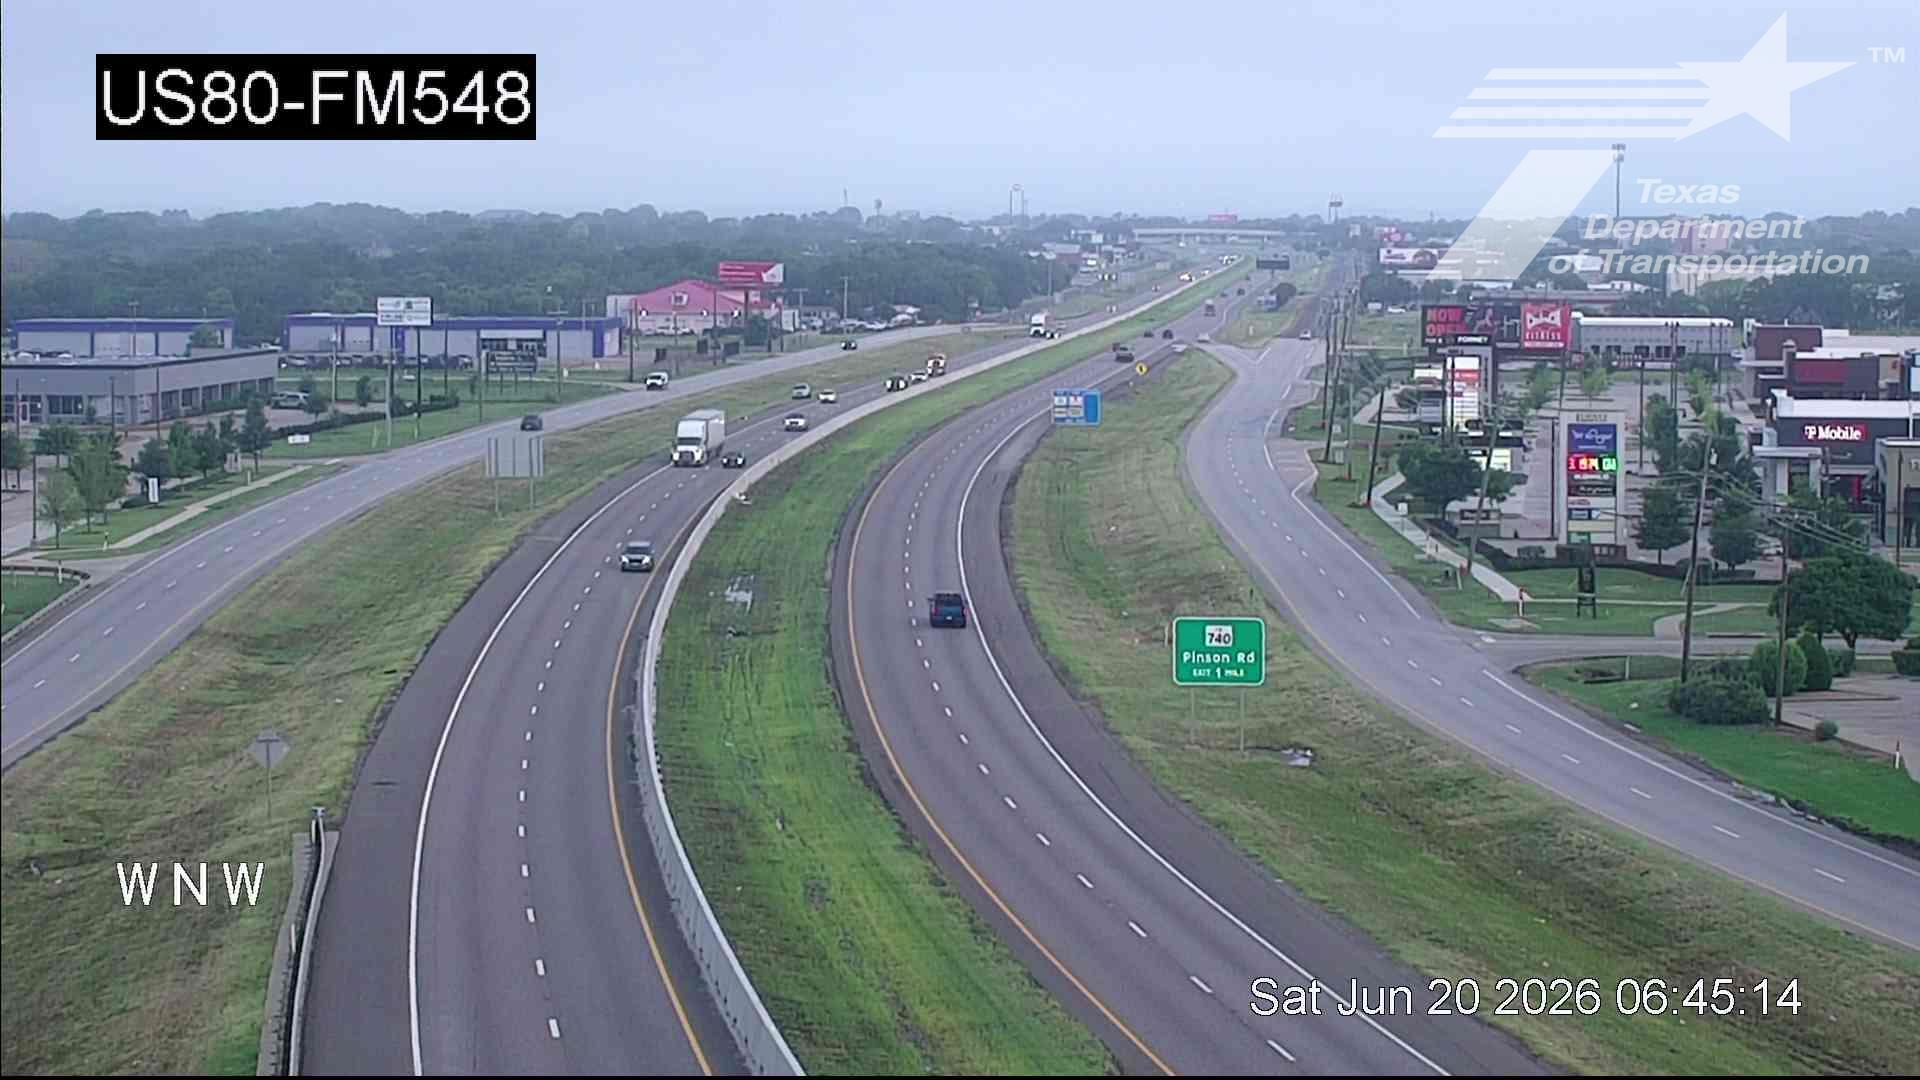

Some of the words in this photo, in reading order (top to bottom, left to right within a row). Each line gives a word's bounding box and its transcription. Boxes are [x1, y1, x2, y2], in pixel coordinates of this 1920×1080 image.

[1207, 633, 1232, 645] 740
[1183, 650, 1231, 664] Pinson
[1237, 651, 1256, 663] Rd
[1215, 666, 1222, 679] 1
